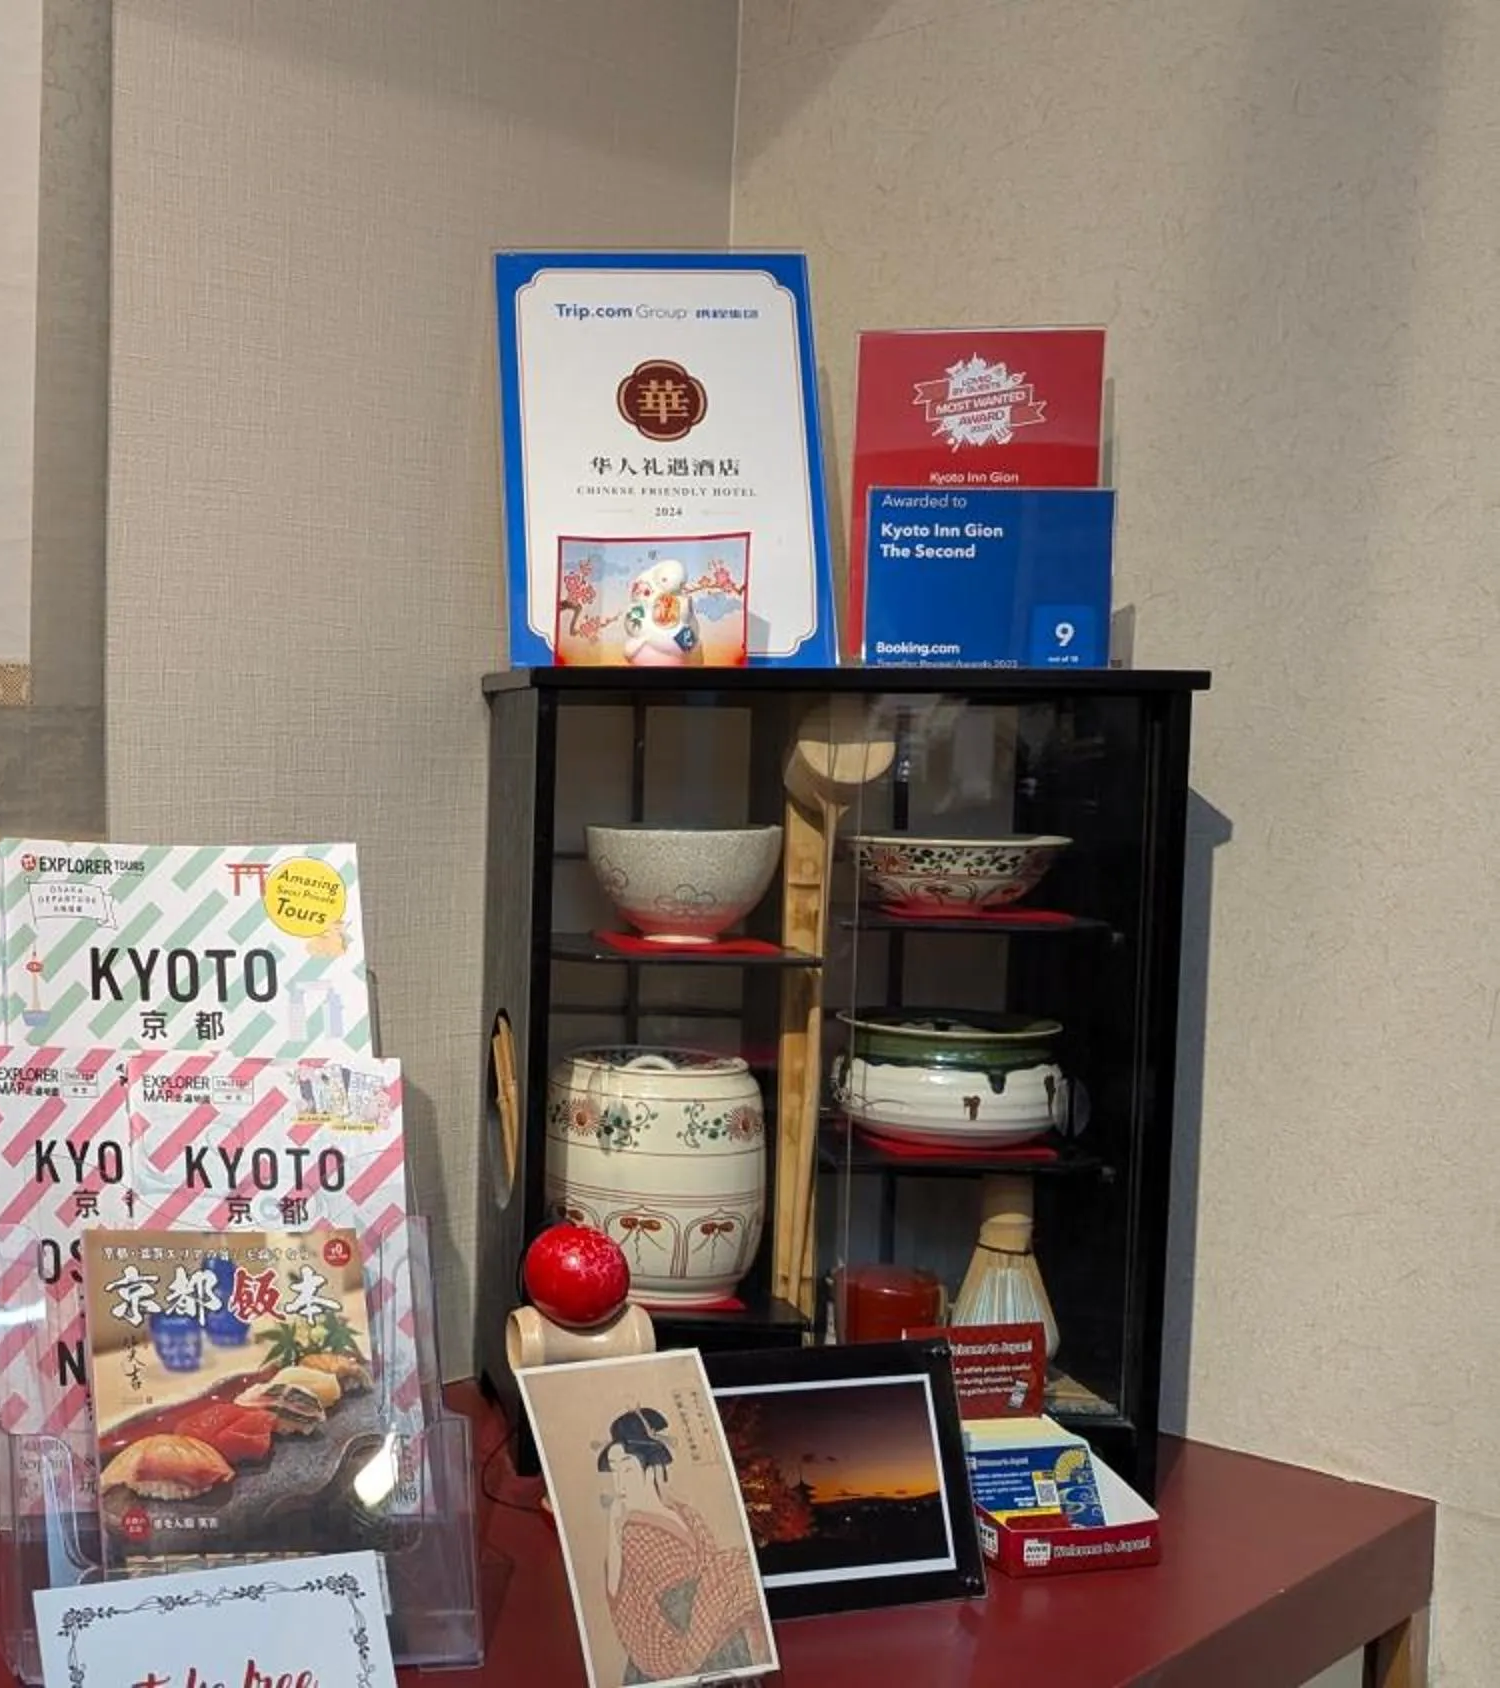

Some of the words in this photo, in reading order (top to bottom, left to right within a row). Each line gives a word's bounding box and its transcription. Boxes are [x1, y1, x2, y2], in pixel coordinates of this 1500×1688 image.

[555, 303, 632, 320] Trip.com
[635, 304, 687, 320] Group
[637, 377, 690, 424] 華
[936, 400, 970, 414] MOST
[973, 391, 1025, 408] WANTED
[959, 410, 1005, 425] AWARD
[590, 456, 741, 476] 华人礼遇酒店
[930, 471, 964, 485] Kyoto
[968, 471, 986, 483] Inn
[989, 471, 1020, 483] Gion
[577, 486, 635, 495] CHINESE
[641, 487, 708, 497] FRIENDLY
[713, 487, 758, 497] HOTEL
[882, 494, 949, 509] Awarded
[952, 497, 968, 509] to
[654, 507, 683, 517] 2024
[881, 522, 931, 542] Kyoto
[934, 523, 960, 538] Inn
[964, 523, 1004, 538] Gion
[880, 543, 911, 559] The
[915, 543, 977, 560] Second
[1054, 621, 1076, 648] 9
[876, 641, 961, 657] Booking.com
[39, 855, 113, 875] EXPLORER
[114, 860, 145, 872] TOURS
[277, 868, 340, 896] Amazing
[277, 897, 328, 925] Tours
[90, 946, 278, 1003] KYOTO
[142, 1074, 211, 1090] EXPLORER
[143, 1089, 173, 1103] MAP
[185, 1145, 345, 1190] KYOTO
